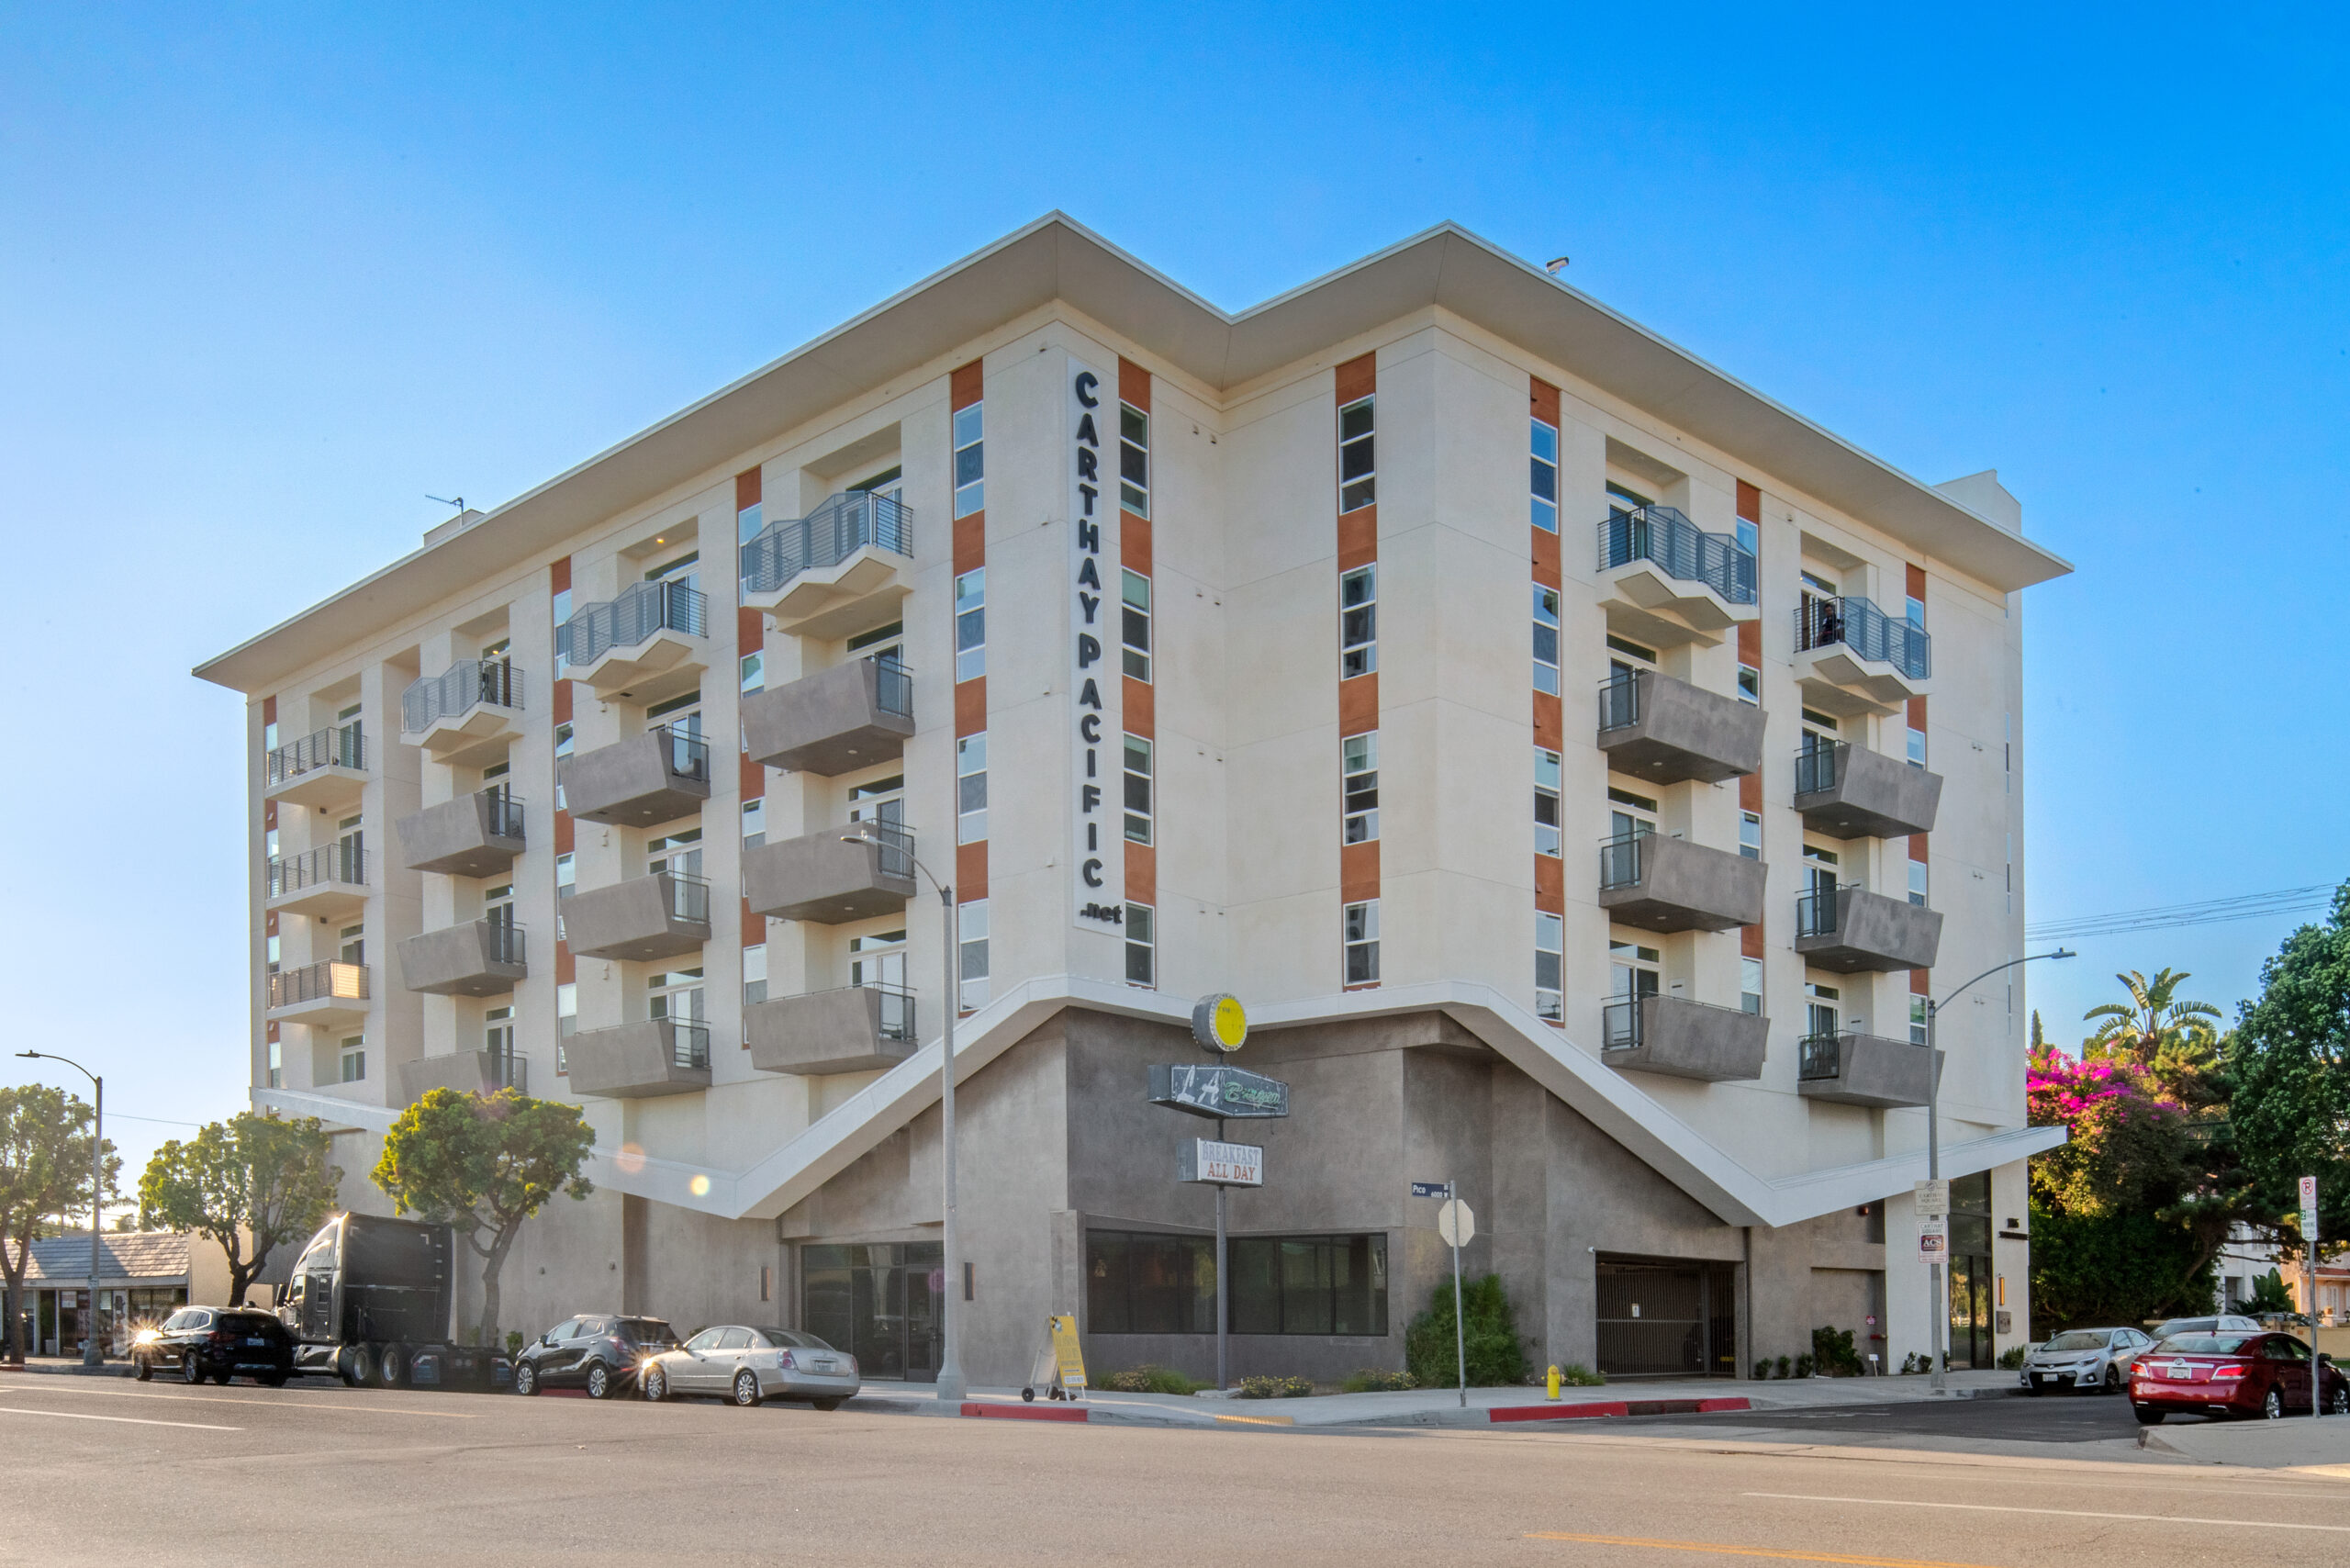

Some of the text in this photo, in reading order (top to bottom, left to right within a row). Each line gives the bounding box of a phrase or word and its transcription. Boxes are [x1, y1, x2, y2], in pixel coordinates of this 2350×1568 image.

[1080, 902, 1122, 924] .net
[1202, 1144, 1260, 1166] BREAKFAST
[1207, 1161, 1256, 1182] ALL DAY
[1413, 1184, 1426, 1193] Pico
